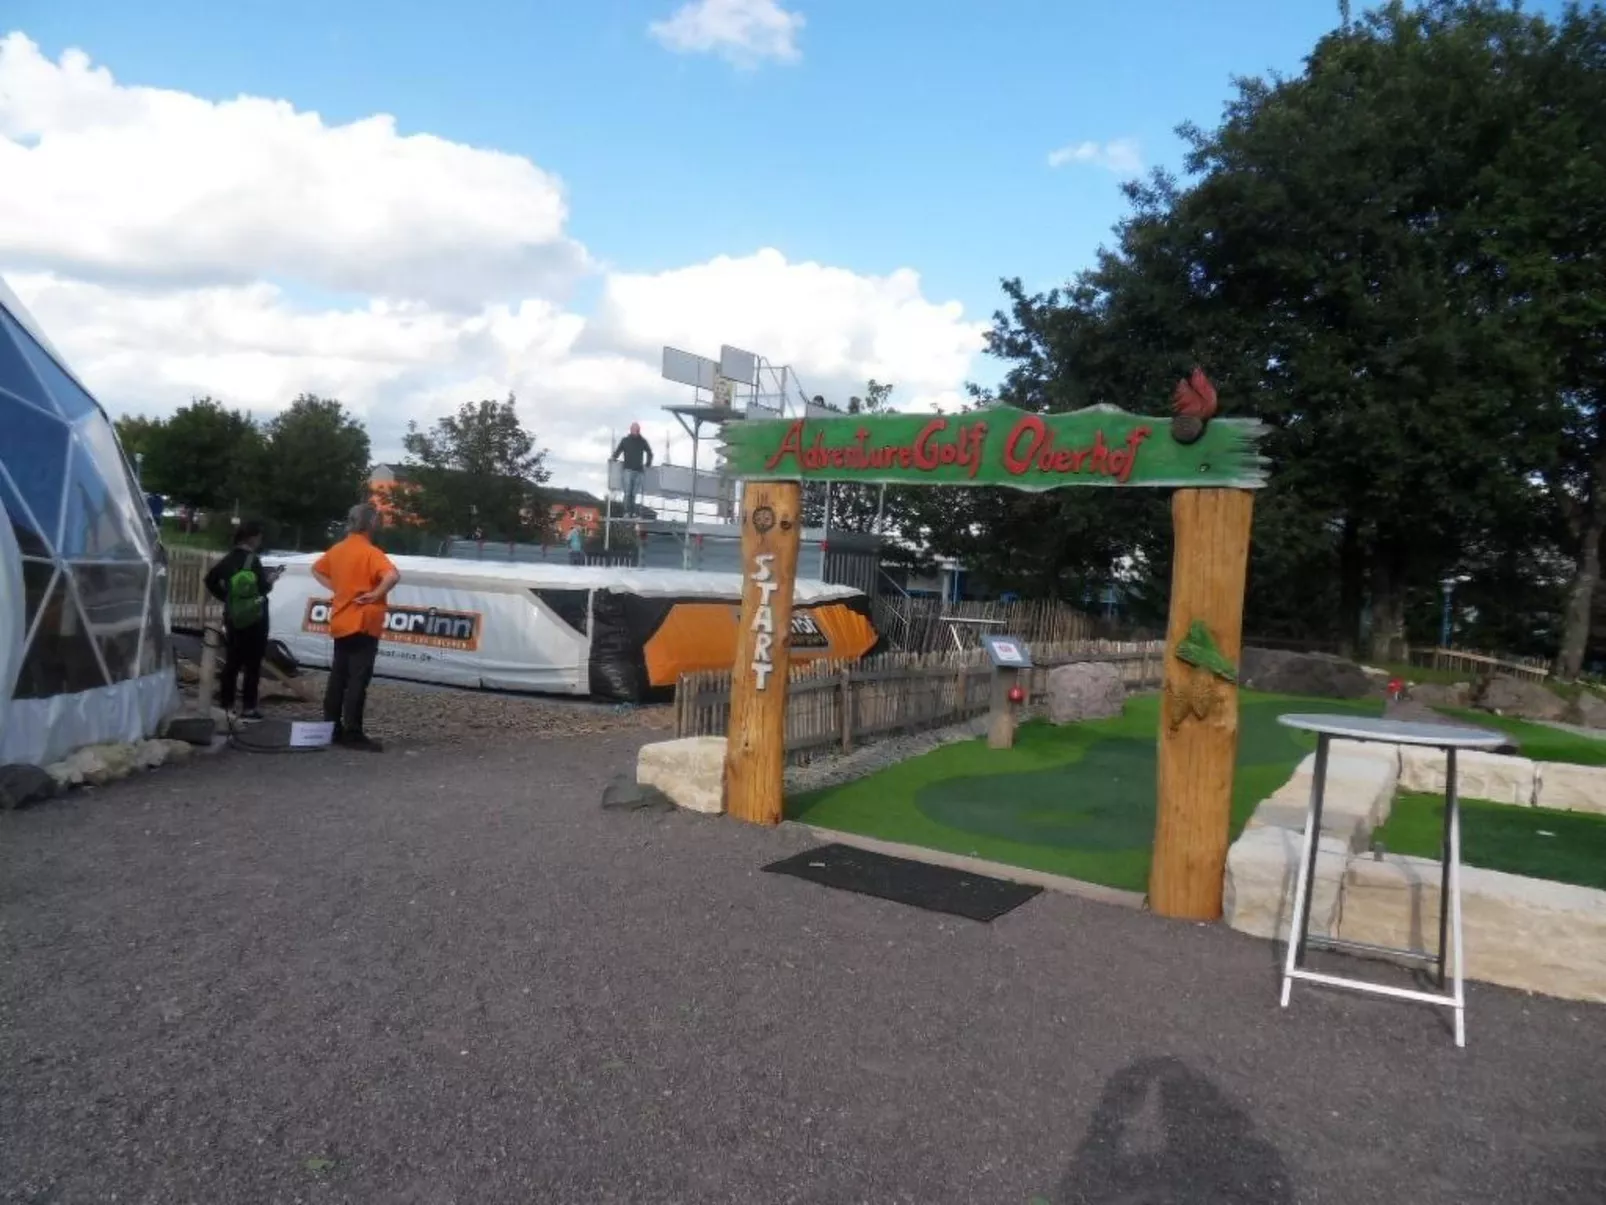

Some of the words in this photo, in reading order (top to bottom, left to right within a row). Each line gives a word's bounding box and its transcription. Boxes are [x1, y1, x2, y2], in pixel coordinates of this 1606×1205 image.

[766, 418, 987, 478] AdventureGolf
[1003, 416, 1151, 483] Oberhof
[751, 554, 778, 690] START
